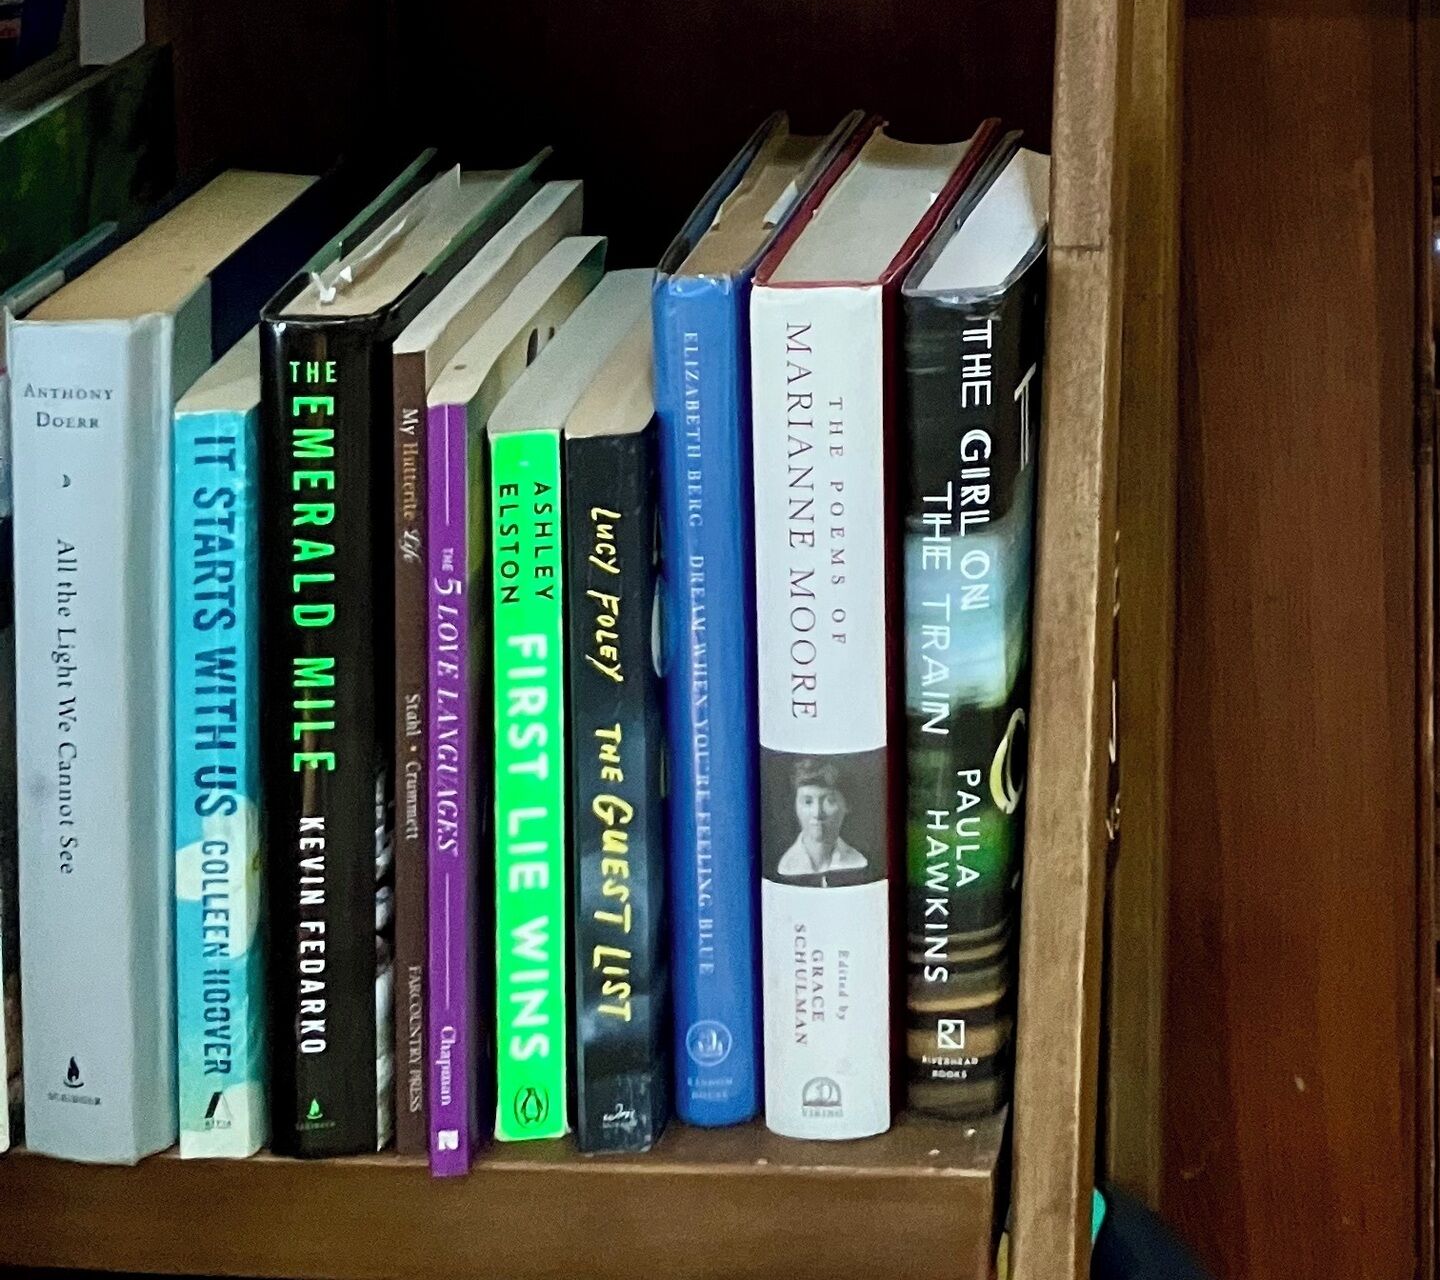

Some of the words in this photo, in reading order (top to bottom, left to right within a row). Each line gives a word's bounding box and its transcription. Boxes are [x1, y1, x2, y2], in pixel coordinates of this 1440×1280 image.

[24, 382, 114, 401] ANTHONY
[289, 361, 337, 384] THE
[961, 319, 992, 408] THE
[36, 412, 100, 429] DOERR
[194, 435, 237, 472] IT
[786, 323, 815, 549] MARIANNE
[828, 397, 843, 458] THE
[292, 395, 335, 627] EMERALD
[960, 429, 991, 537] GIRL
[56, 538, 78, 576] All
[193, 486, 237, 632] STARTS
[440, 547, 454, 571] THE
[499, 483, 520, 604] ELSTON
[533, 482, 554, 601] ASHLEY
[830, 481, 845, 585] POEMS
[922, 482, 952, 571] THE
[56, 581, 78, 619] the
[435, 578, 461, 596] 5
[960, 551, 990, 611] ON
[50, 628, 78, 688] Light
[437, 604, 459, 677] LOVE
[790, 568, 817, 720] MOORE
[832, 609, 846, 644] OF
[921, 594, 950, 735] TRAIN
[57, 697, 77, 732] We
[194, 646, 237, 751] WITH
[293, 657, 335, 772] MILE
[507, 633, 548, 780] FIRST
[57, 743, 78, 826] Cannot
[194, 765, 237, 818] US
[436, 687, 458, 852] LANGUAGES
[594, 724, 623, 783] THE
[58, 837, 78, 875] See
[299, 816, 326, 904] KEVIN
[508, 808, 550, 892] LIE
[592, 795, 634, 934] GUEST
[955, 769, 980, 888] PAULA
[924, 810, 949, 984] HAWKINS
[299, 921, 327, 1054] FEDARKO
[509, 915, 550, 1061] WINS
[794, 925, 808, 1047] SCHULMAN
[812, 949, 825, 1023] GRACE
[435, 1027, 457, 1106] Chapman
[932, 1069, 967, 1078] BOOKS
